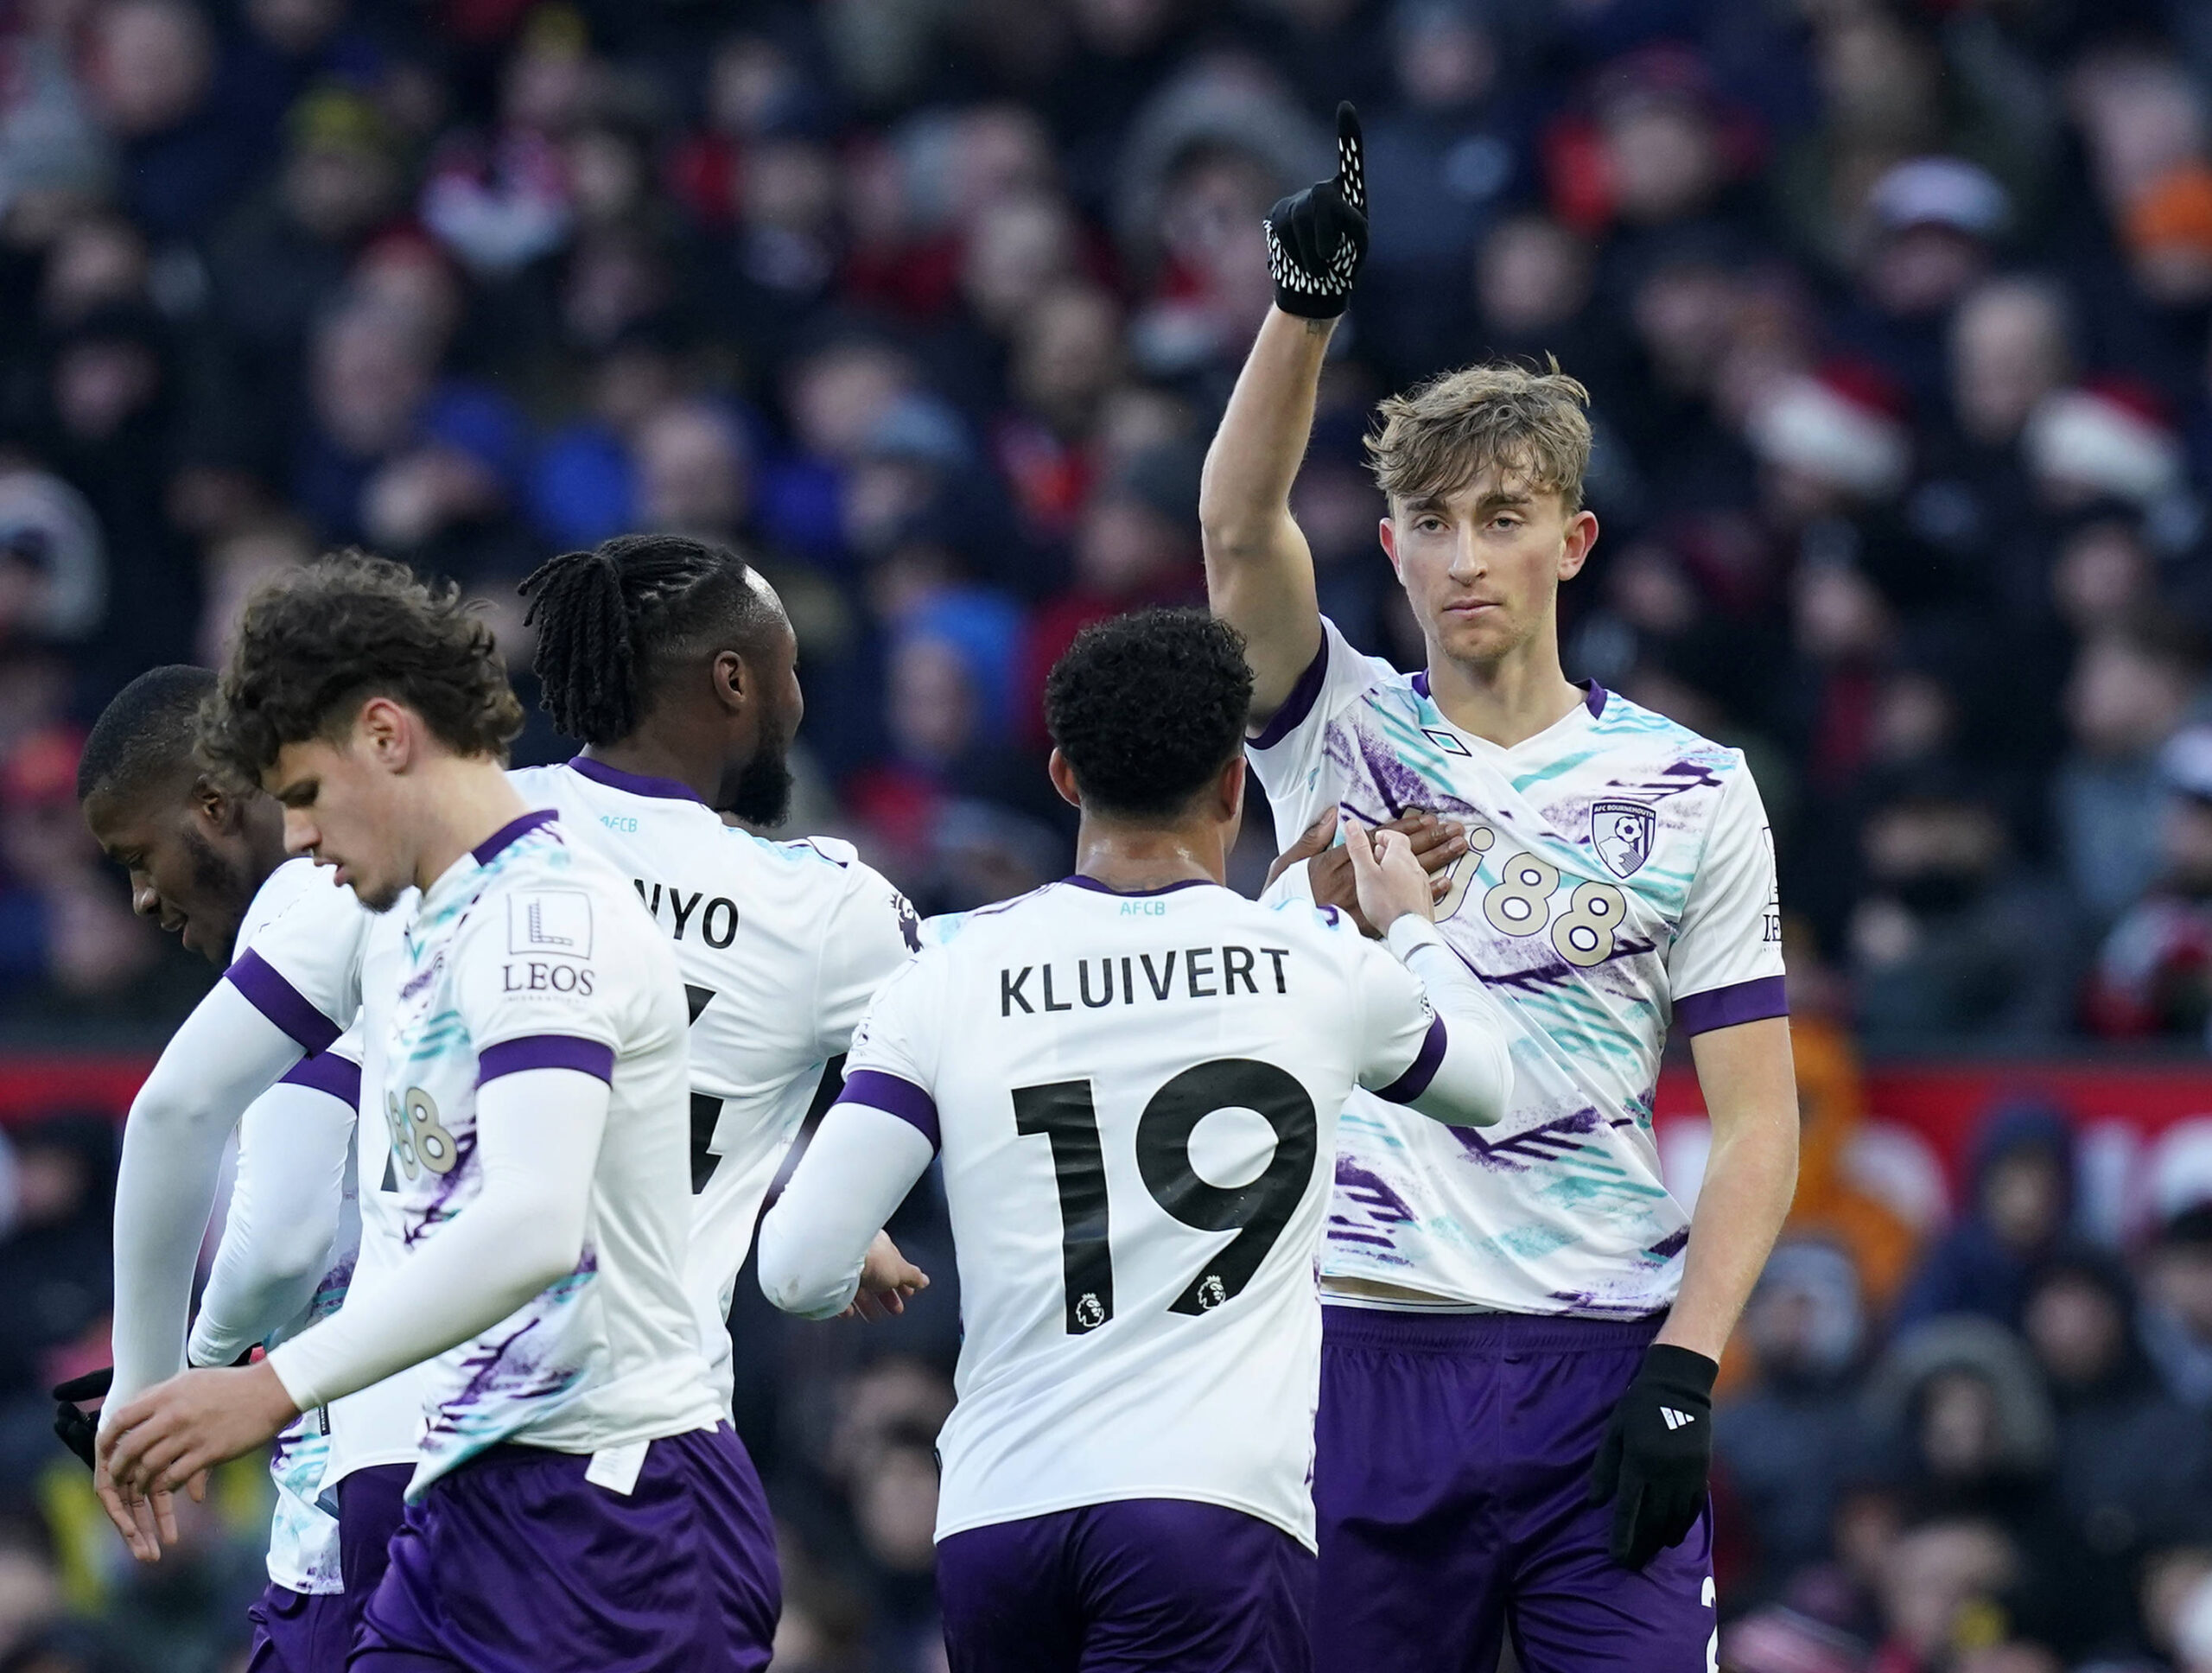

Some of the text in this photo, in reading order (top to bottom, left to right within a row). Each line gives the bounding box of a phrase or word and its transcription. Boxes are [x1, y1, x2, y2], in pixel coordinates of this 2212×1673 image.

[600, 816, 638, 832] AFCB
[1120, 900, 1166, 916] AFCB
[502, 962, 595, 996] LEOS
[1001, 945, 1289, 1017] KLUIVERT
[1011, 1058, 1318, 1335] 19
